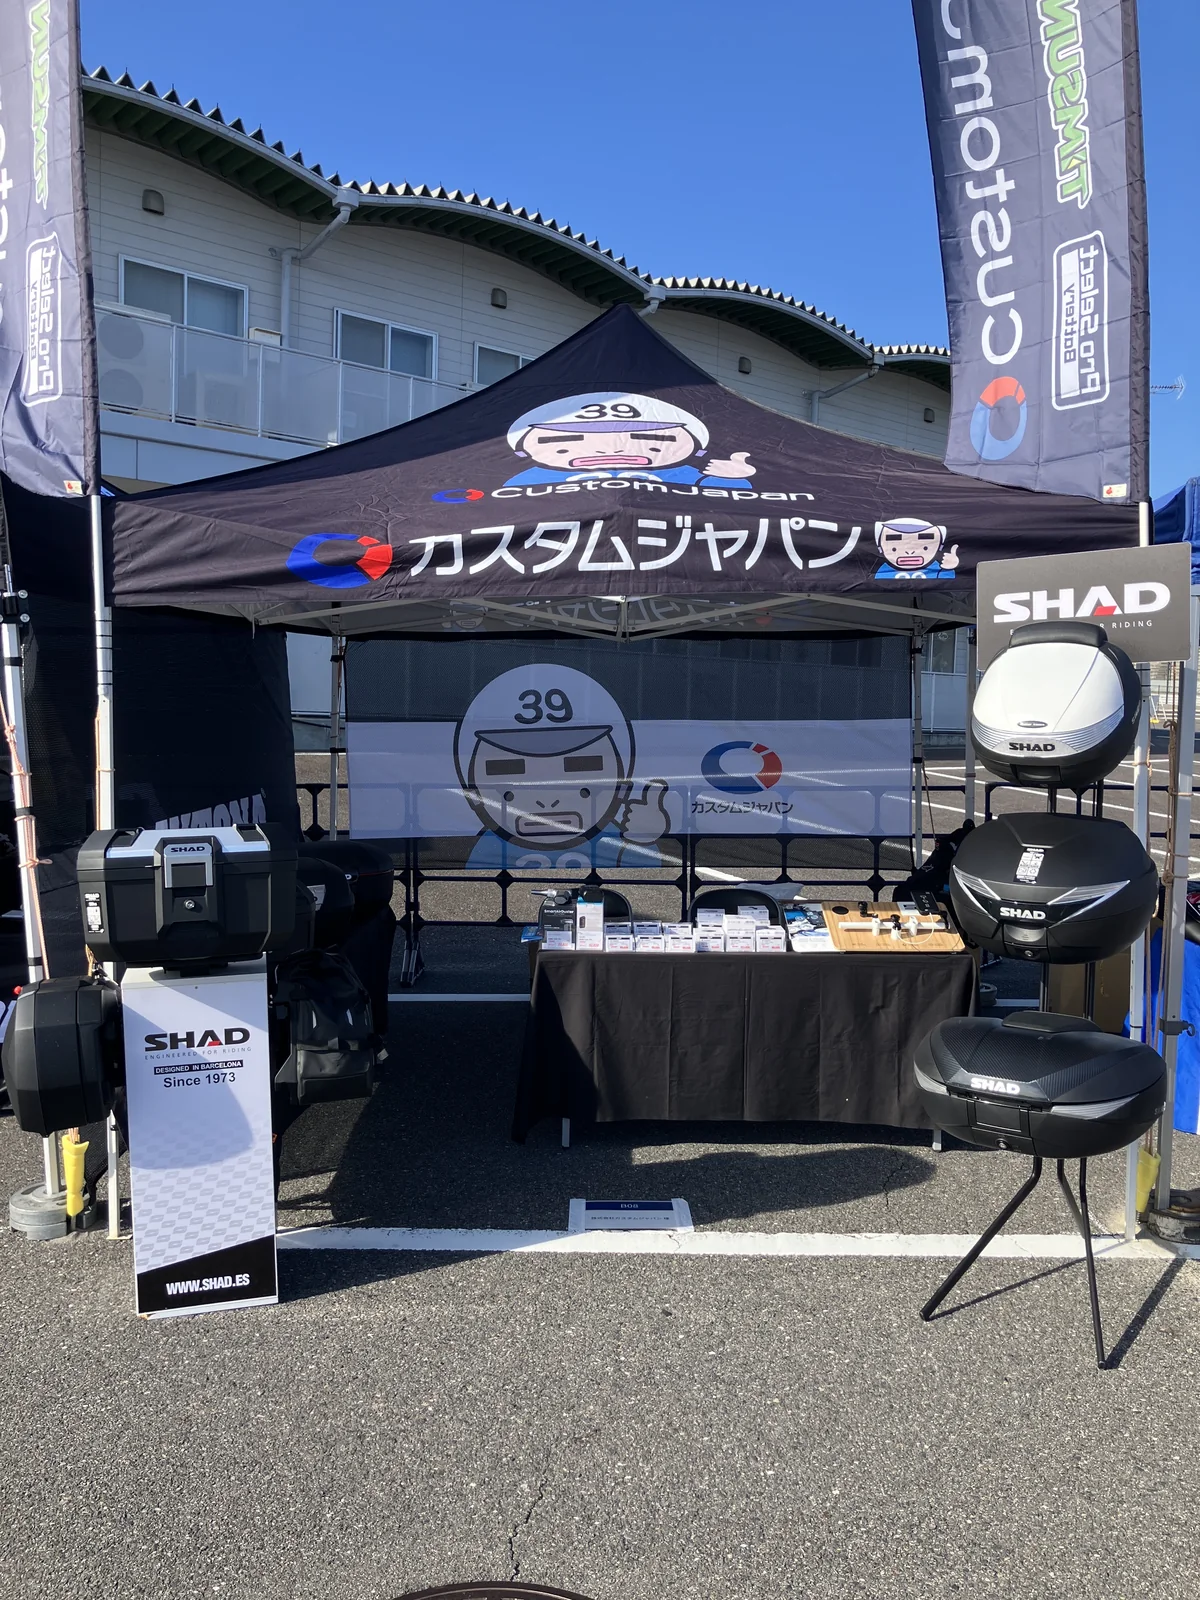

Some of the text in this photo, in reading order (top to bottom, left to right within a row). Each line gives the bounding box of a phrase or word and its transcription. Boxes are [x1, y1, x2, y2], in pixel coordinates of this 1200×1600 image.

[575, 403, 641, 419] 39
[408, 515, 862, 577] カスタムジャパン
[993, 582, 1171, 624] SHAD
[1111, 619, 1153, 630] RIDING
[514, 688, 573, 725] 39
[1009, 742, 1056, 752] SHAD
[691, 801, 794, 814] カスタムジャパン
[1000, 907, 1046, 920] SHAD
[144, 1027, 251, 1052] SHAD
[145, 1052, 198, 1060] ENGINEERED
[155, 1060, 242, 1074] DESIGNED IN BARCELONA
[163, 1071, 236, 1088] Since 1973
[970, 1077, 1021, 1095] SHAD
[166, 1273, 250, 1295] WWW.SHAD.ES
